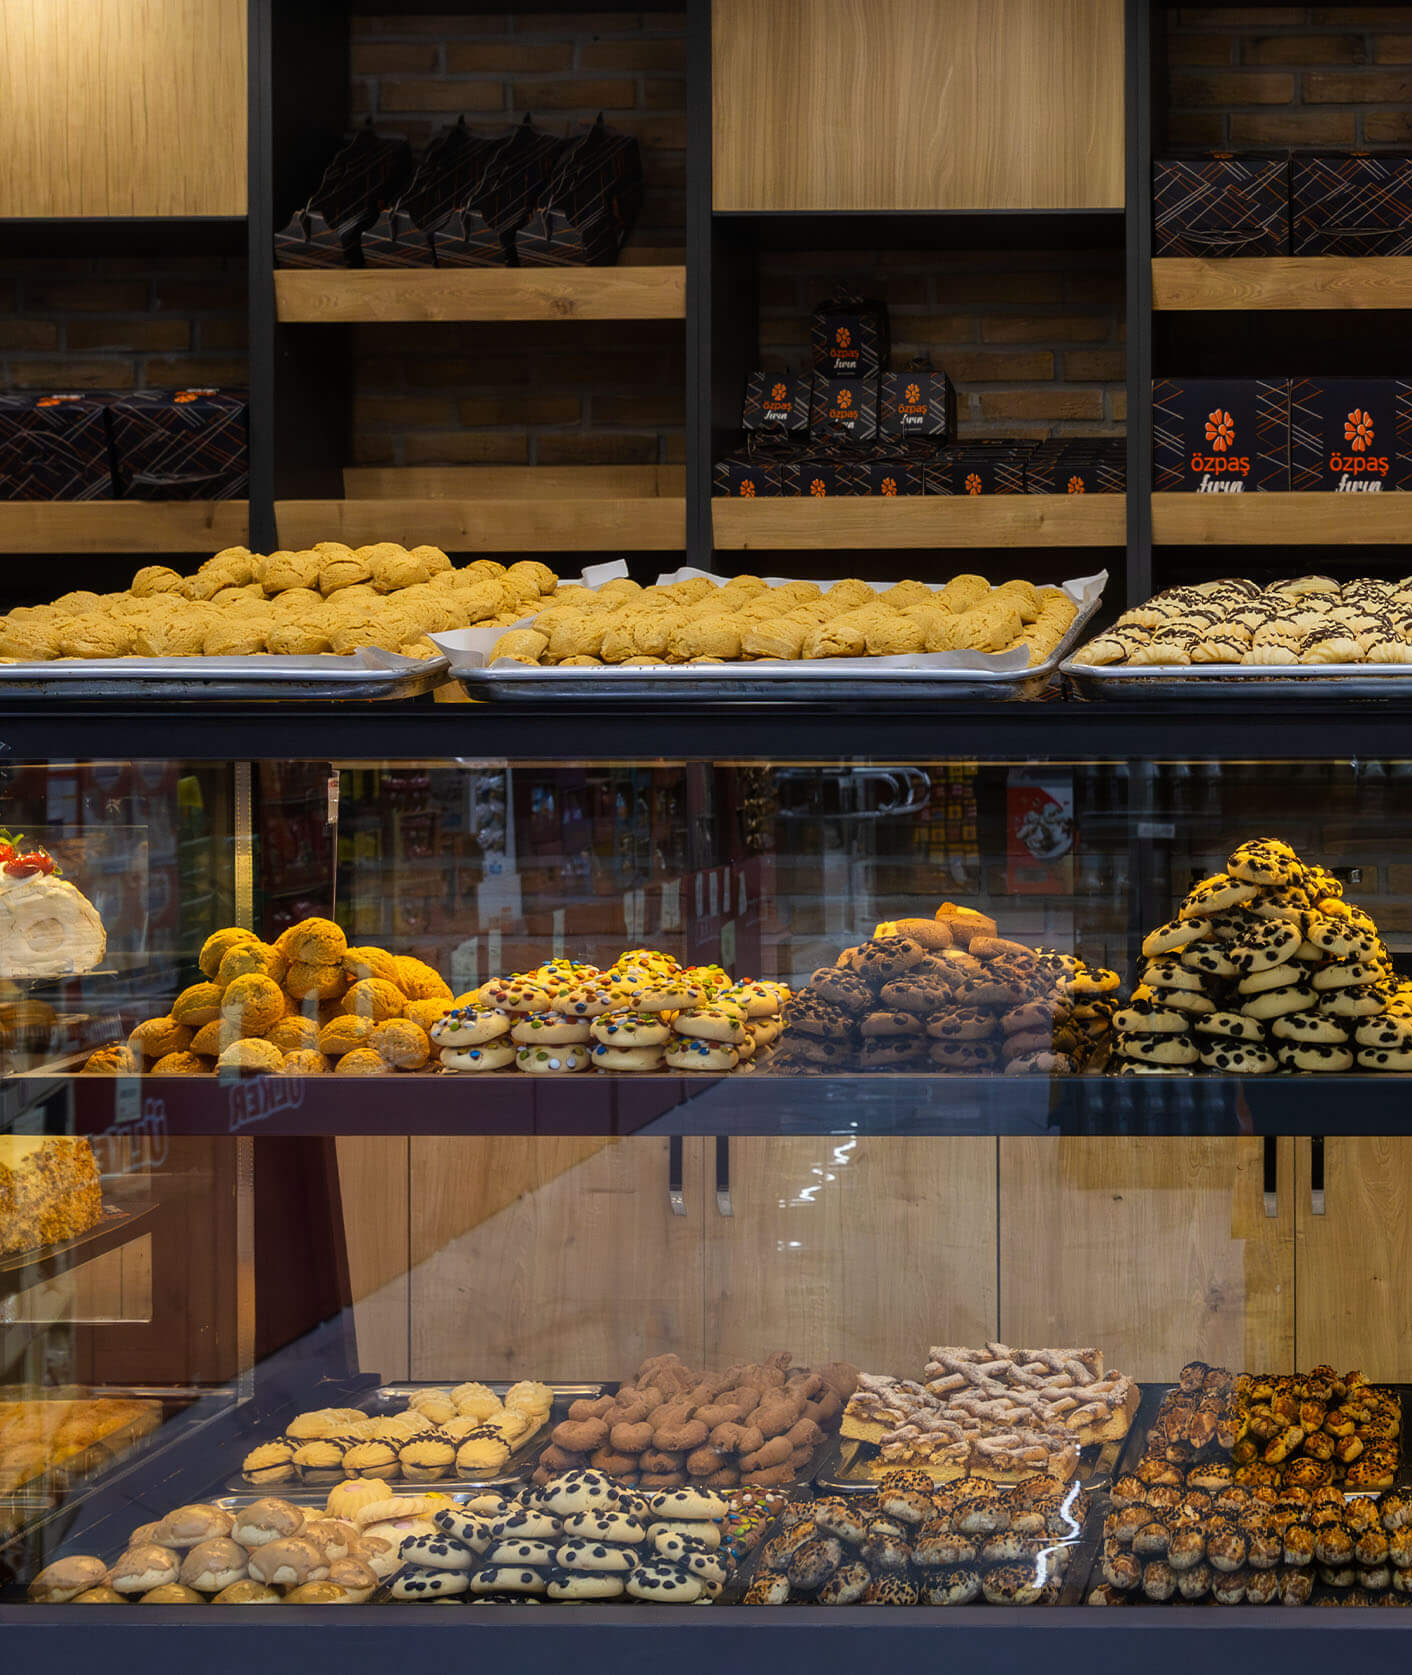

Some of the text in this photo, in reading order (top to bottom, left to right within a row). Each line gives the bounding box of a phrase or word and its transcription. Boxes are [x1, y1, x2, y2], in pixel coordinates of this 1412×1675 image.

[830, 348, 859, 360] özpaş
[762, 401, 792, 412] özpaş
[897, 404, 927, 415] özpaş
[829, 408, 858, 420] özpaş
[1191, 451, 1251, 477] özpaş
[1329, 451, 1390, 478] özpaş
